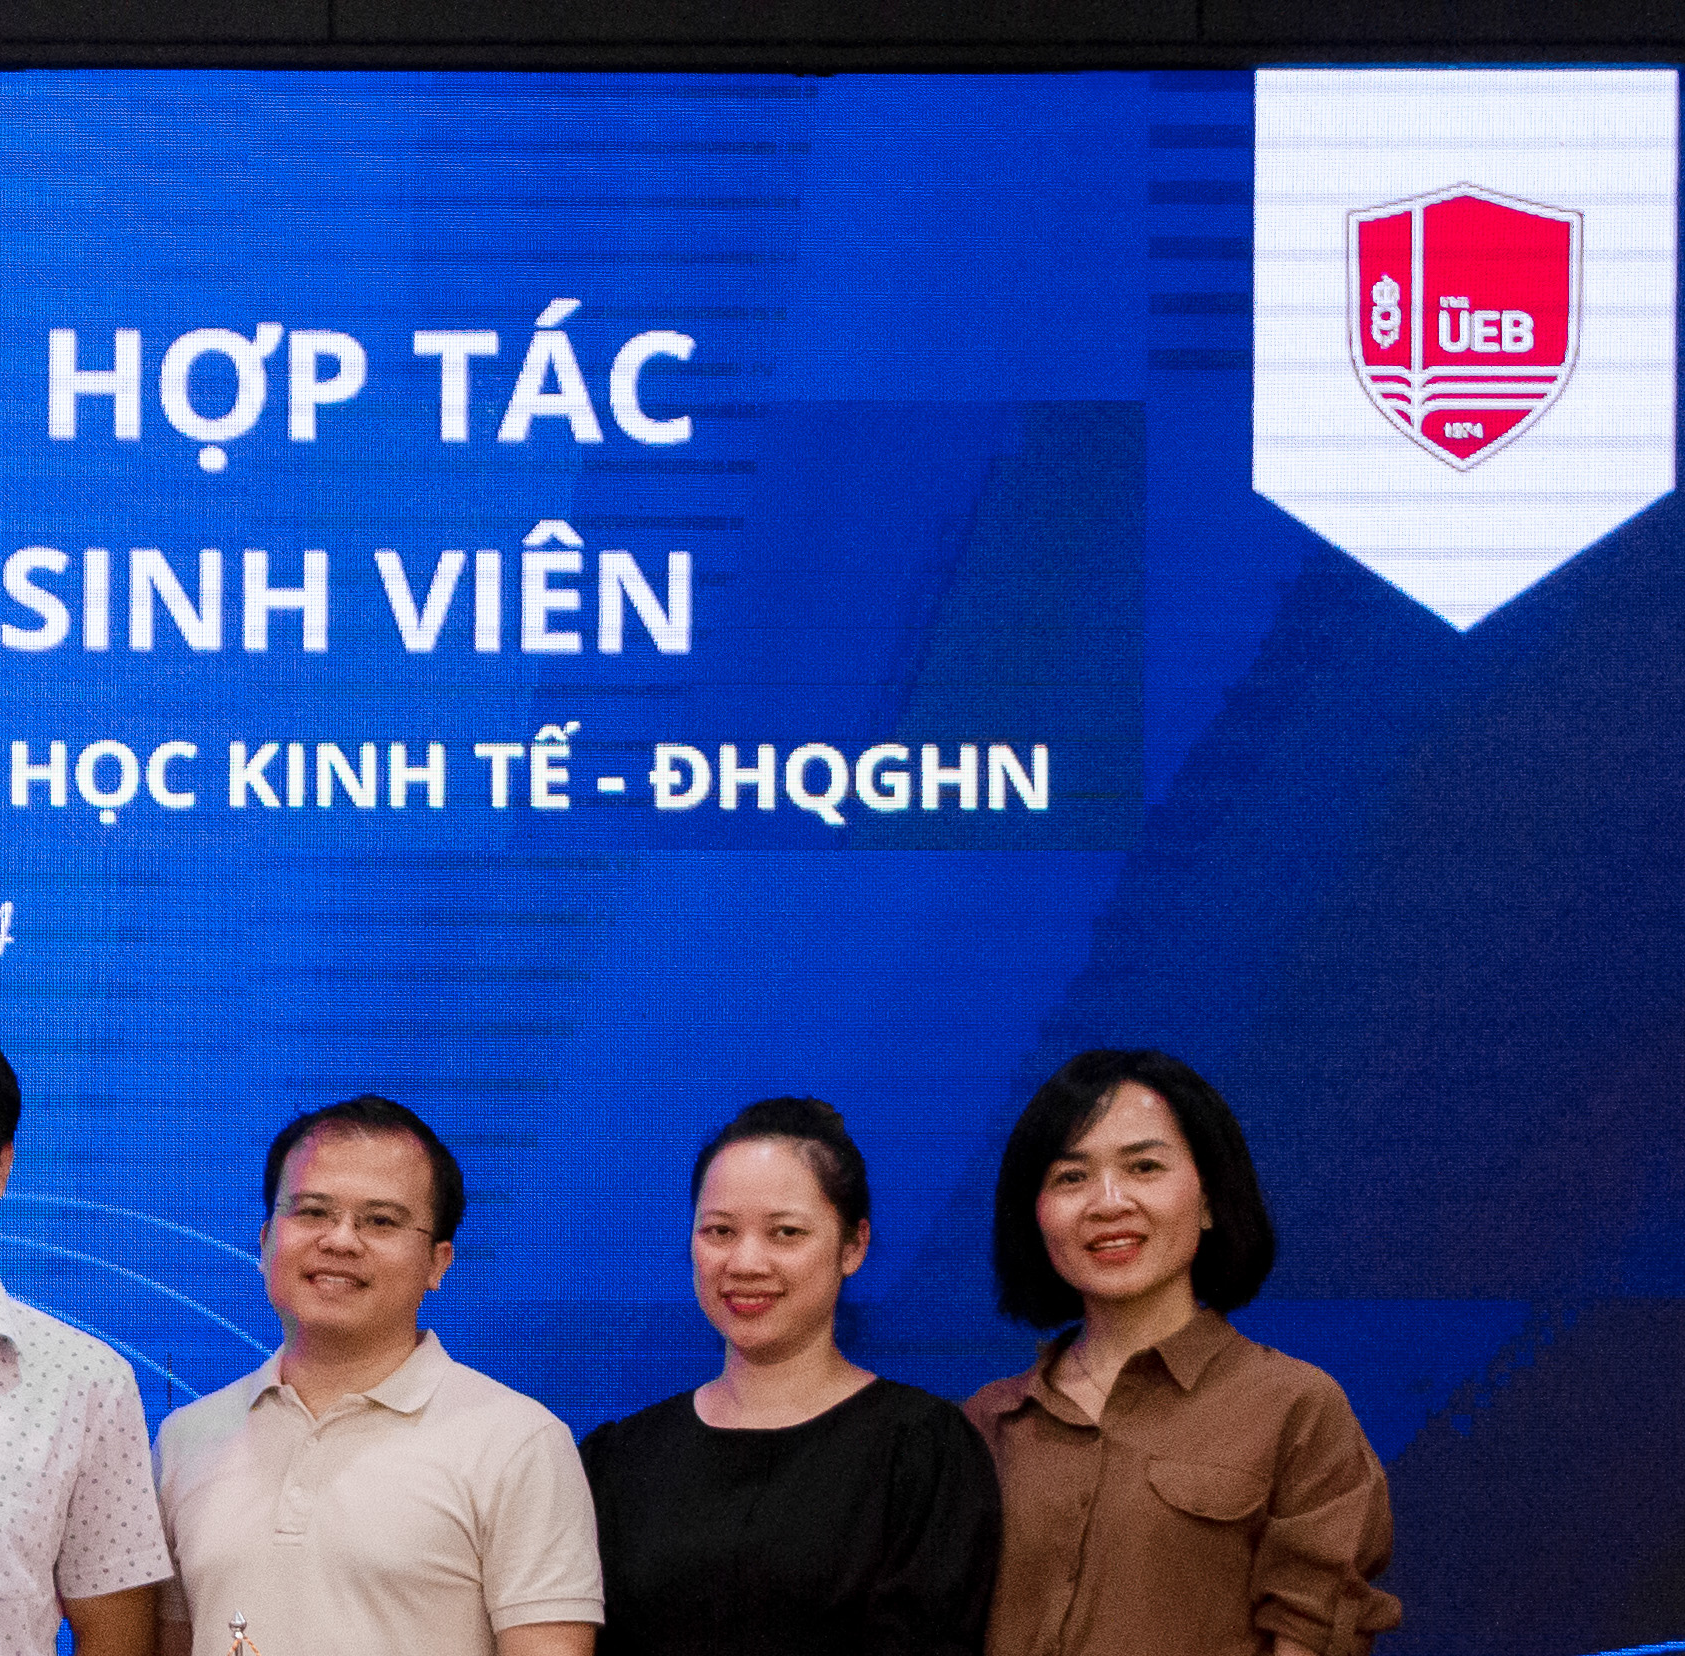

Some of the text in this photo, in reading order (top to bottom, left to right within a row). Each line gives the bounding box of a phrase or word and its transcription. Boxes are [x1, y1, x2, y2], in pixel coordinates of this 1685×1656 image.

[46, 320, 367, 473] HỢP
[412, 296, 696, 445] TÁC
[0, 545, 330, 653] SINH
[373, 518, 692, 654] VIÊN
[9, 738, 199, 826] HỌC
[227, 739, 446, 810] KINH
[472, 719, 582, 810] TẾ
[597, 776, 625, 791] -
[647, 741, 1050, 826] ĐHQGHN
